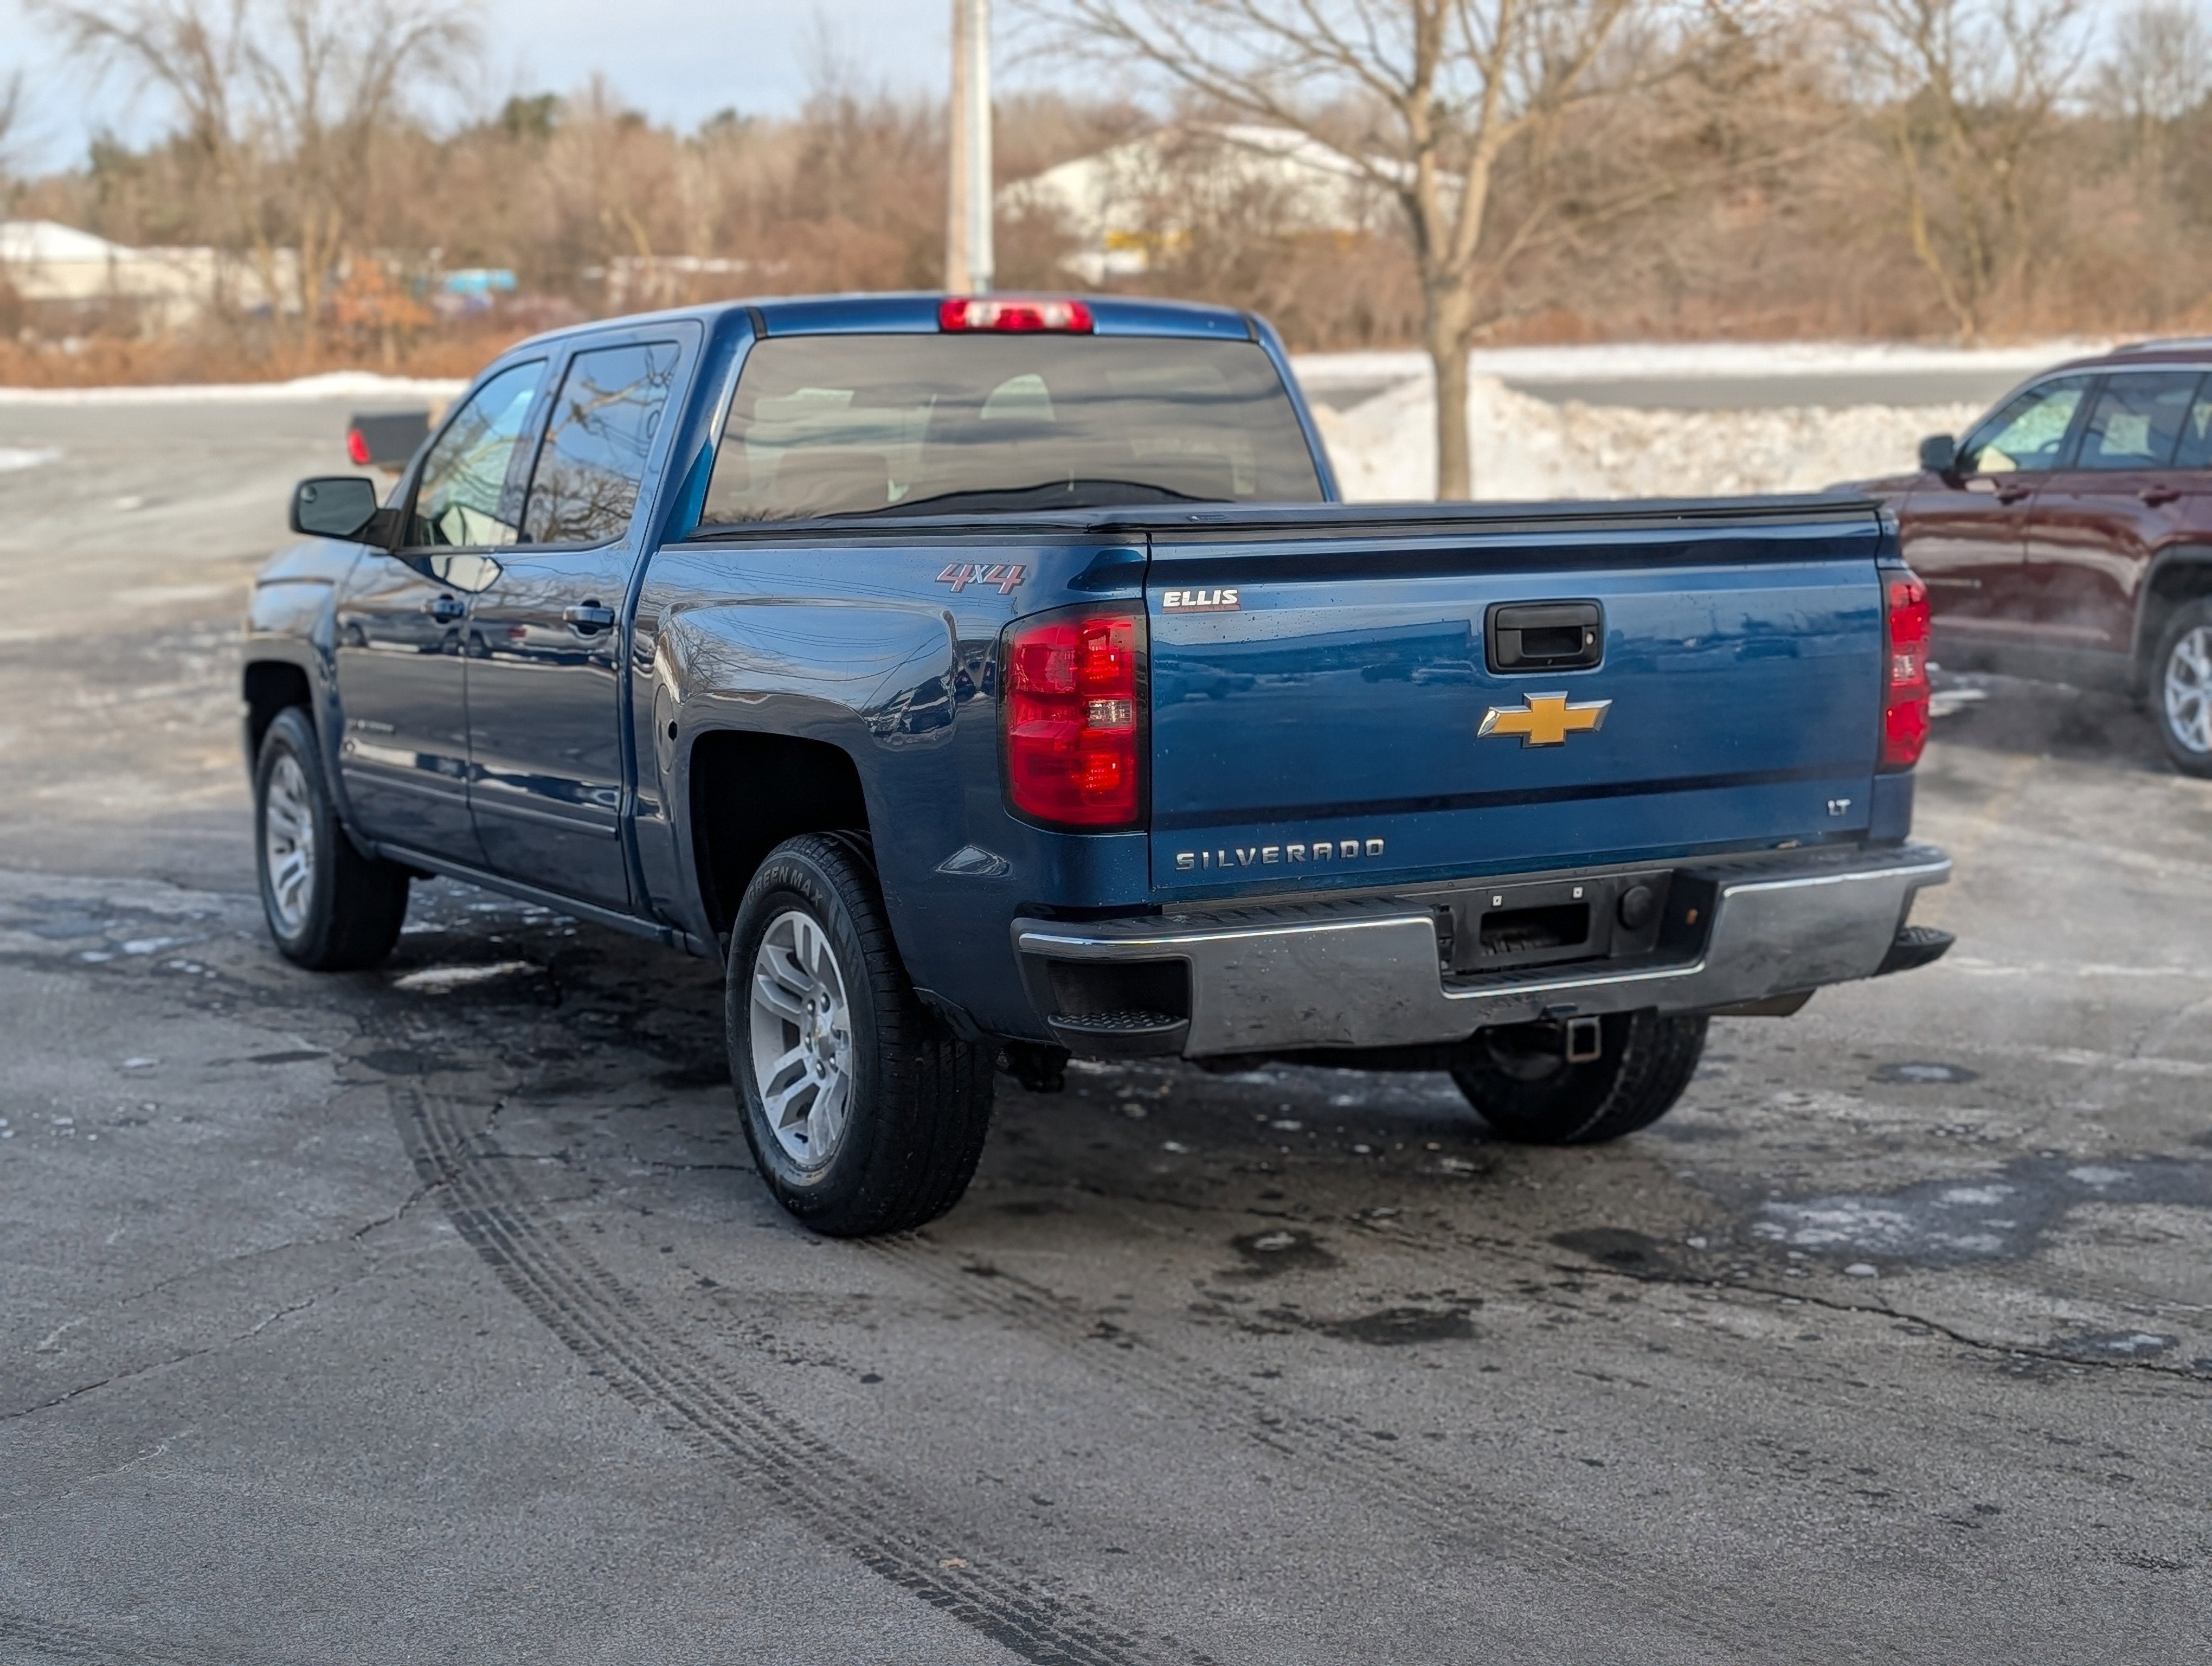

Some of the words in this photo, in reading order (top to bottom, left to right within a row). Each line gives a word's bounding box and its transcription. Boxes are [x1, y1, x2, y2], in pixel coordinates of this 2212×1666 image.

[1163, 589, 1238, 607] ELLIS
[1828, 799, 1851, 816] LT
[1175, 839, 1384, 870] SILVERADO
[747, 866, 789, 905] GREEN
[790, 869, 824, 907] MAX
